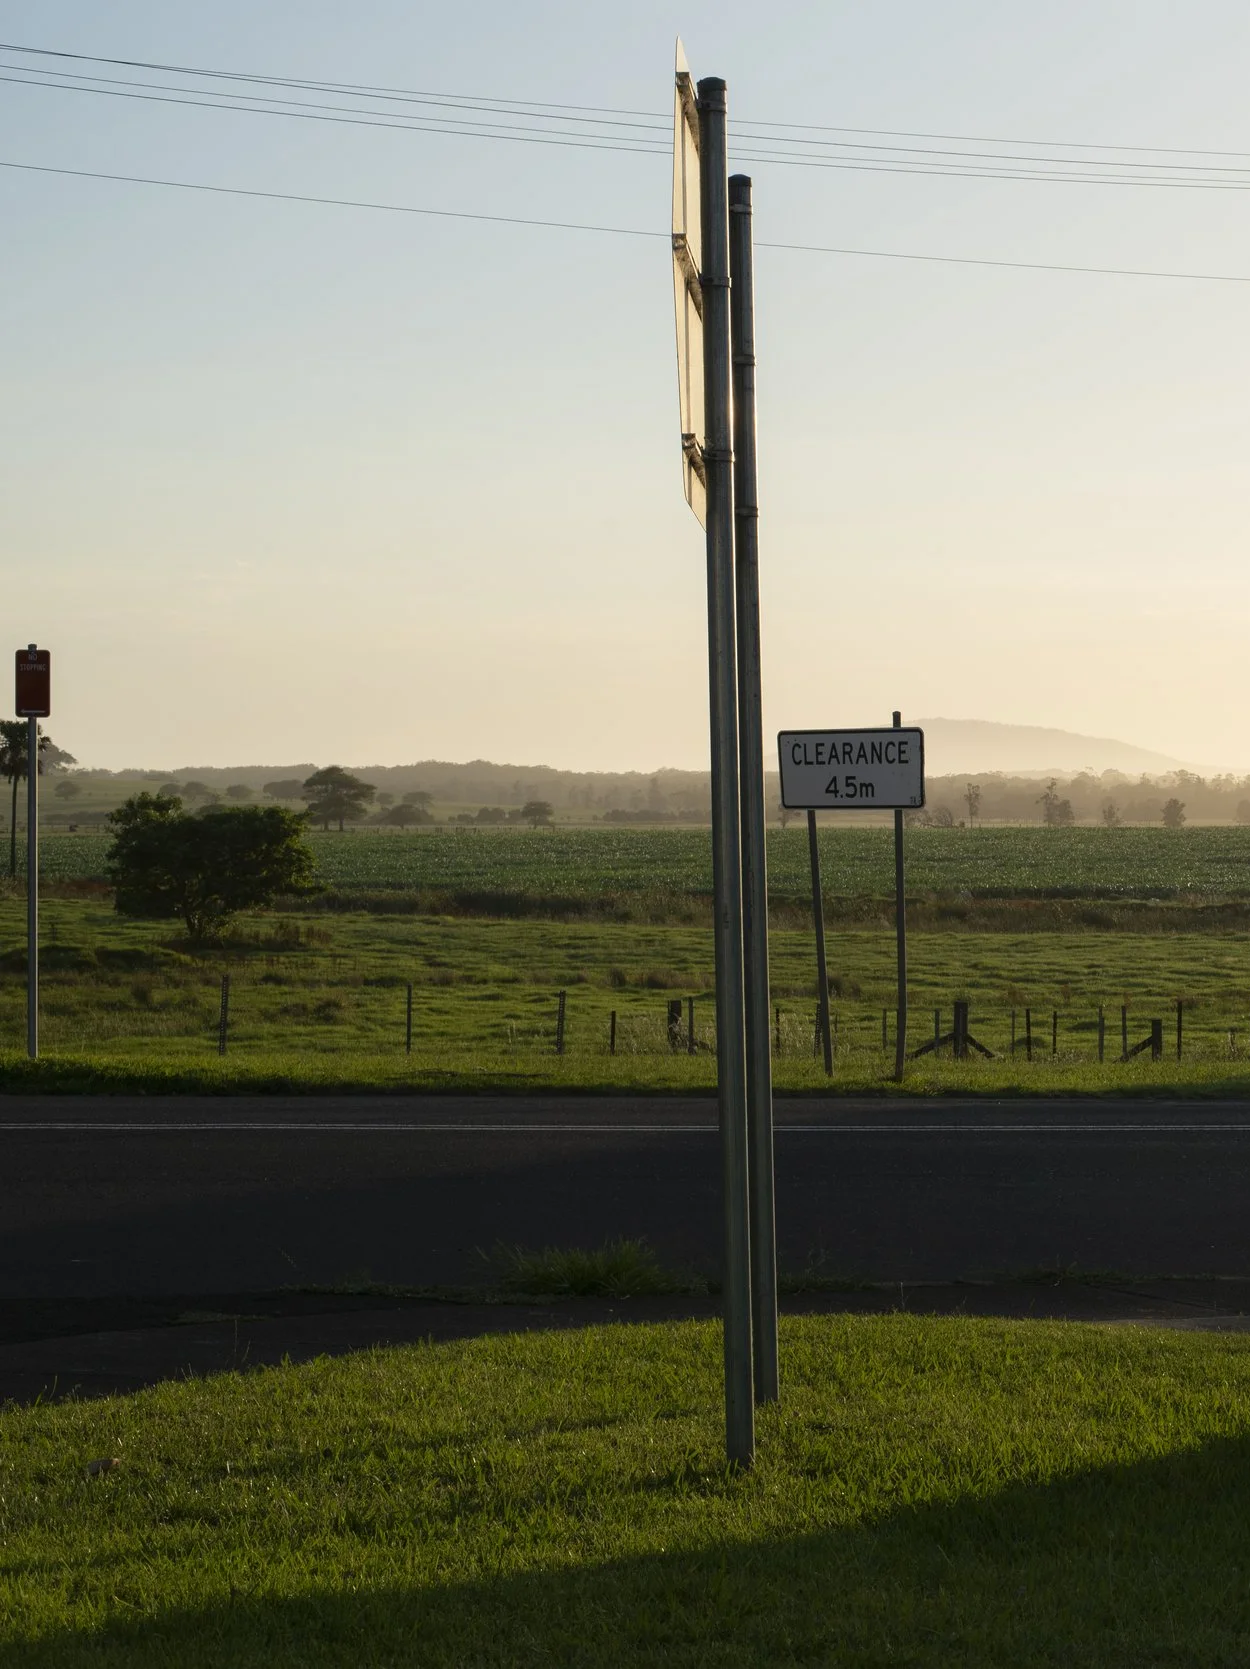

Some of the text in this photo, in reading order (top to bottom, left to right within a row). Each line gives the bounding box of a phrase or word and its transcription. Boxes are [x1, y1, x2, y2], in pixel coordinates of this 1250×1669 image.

[28, 653, 38, 661] NO
[791, 741, 909, 765] CLEARANCE
[825, 776, 875, 798] 4.5m
